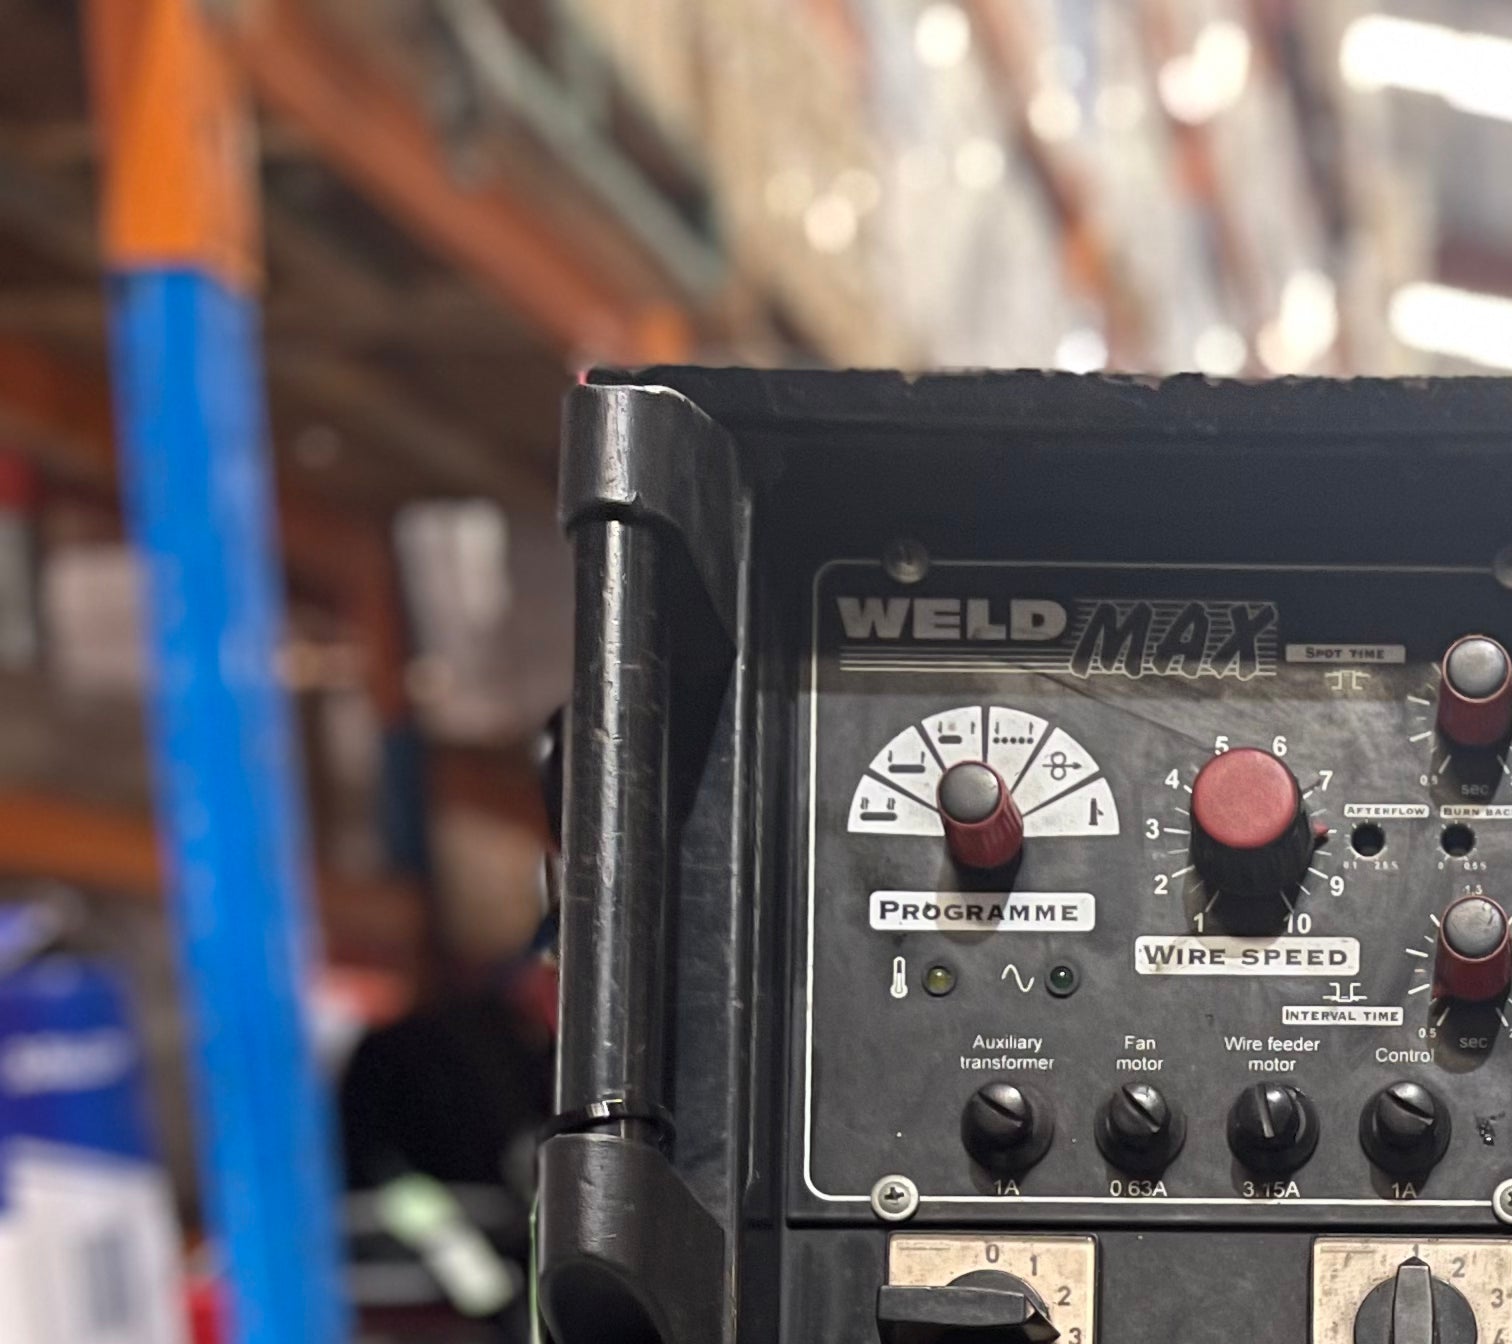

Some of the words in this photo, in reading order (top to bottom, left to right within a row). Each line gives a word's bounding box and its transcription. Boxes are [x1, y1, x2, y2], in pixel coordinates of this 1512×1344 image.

[1214, 736, 1229, 755] 5
[1273, 736, 1287, 756] 6
[1165, 769, 1179, 789] 4
[1319, 770, 1333, 790] 7
[1146, 819, 1159, 839] 3
[1154, 875, 1168, 894] 2
[1330, 876, 1344, 896] 9
[879, 901, 1078, 921] PROGRAMME
[1194, 913, 1204, 932] 1
[1287, 914, 1311, 934] 10
[1143, 945, 1225, 966] WIRE
[1242, 948, 1348, 966] SPEED
[1285, 1010, 1356, 1021] INTERVAL
[1364, 1011, 1399, 1022] TIME
[972, 1035, 1042, 1053] Auxiliary
[1125, 1036, 1156, 1051] Fan
[1224, 1036, 1263, 1052] Wire
[1267, 1036, 1320, 1052] feeder
[1459, 1036, 1488, 1049] sec
[960, 1056, 1055, 1071] transformer
[1116, 1057, 1164, 1071] motor
[1248, 1057, 1296, 1072] motor
[1375, 1047, 1434, 1064] Control
[993, 1181, 1020, 1196] 1A
[1110, 1181, 1168, 1197] 0.63A
[1243, 1181, 1300, 1198] 3.15A
[1391, 1182, 1417, 1198] 1A
[986, 1244, 1000, 1263] 0
[1030, 1255, 1038, 1276] 1
[1452, 1258, 1465, 1278] 2
[1058, 1286, 1071, 1306] 2
[1491, 1288, 1504, 1308] 3
